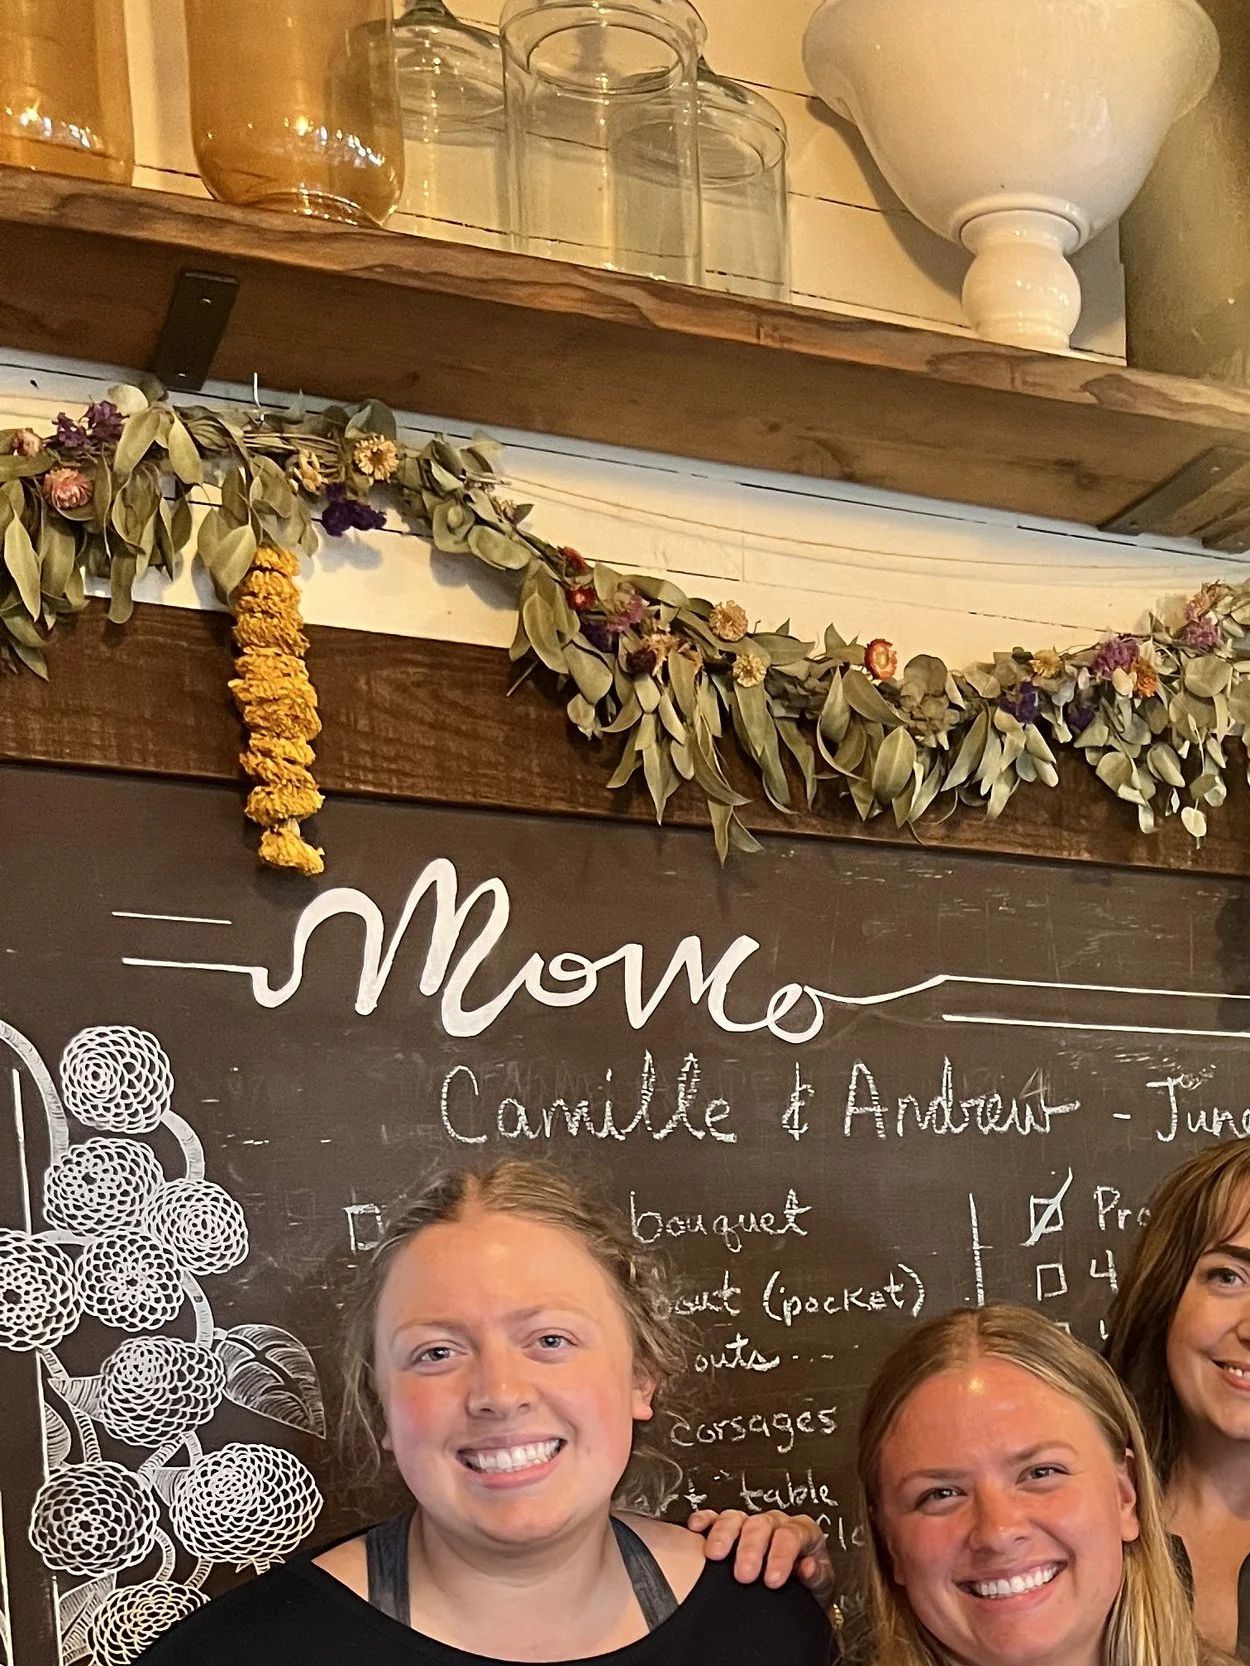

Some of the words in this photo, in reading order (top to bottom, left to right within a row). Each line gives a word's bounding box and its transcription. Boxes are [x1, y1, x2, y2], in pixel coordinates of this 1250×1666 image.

[440, 1049, 738, 1144] Camille
[843, 1055, 1080, 1140] Andrew
[630, 1188, 812, 1253] bouquet
[762, 1263, 926, 1327] (pocket)
[668, 1406, 838, 1454] corsages
[740, 1469, 839, 1512] table
